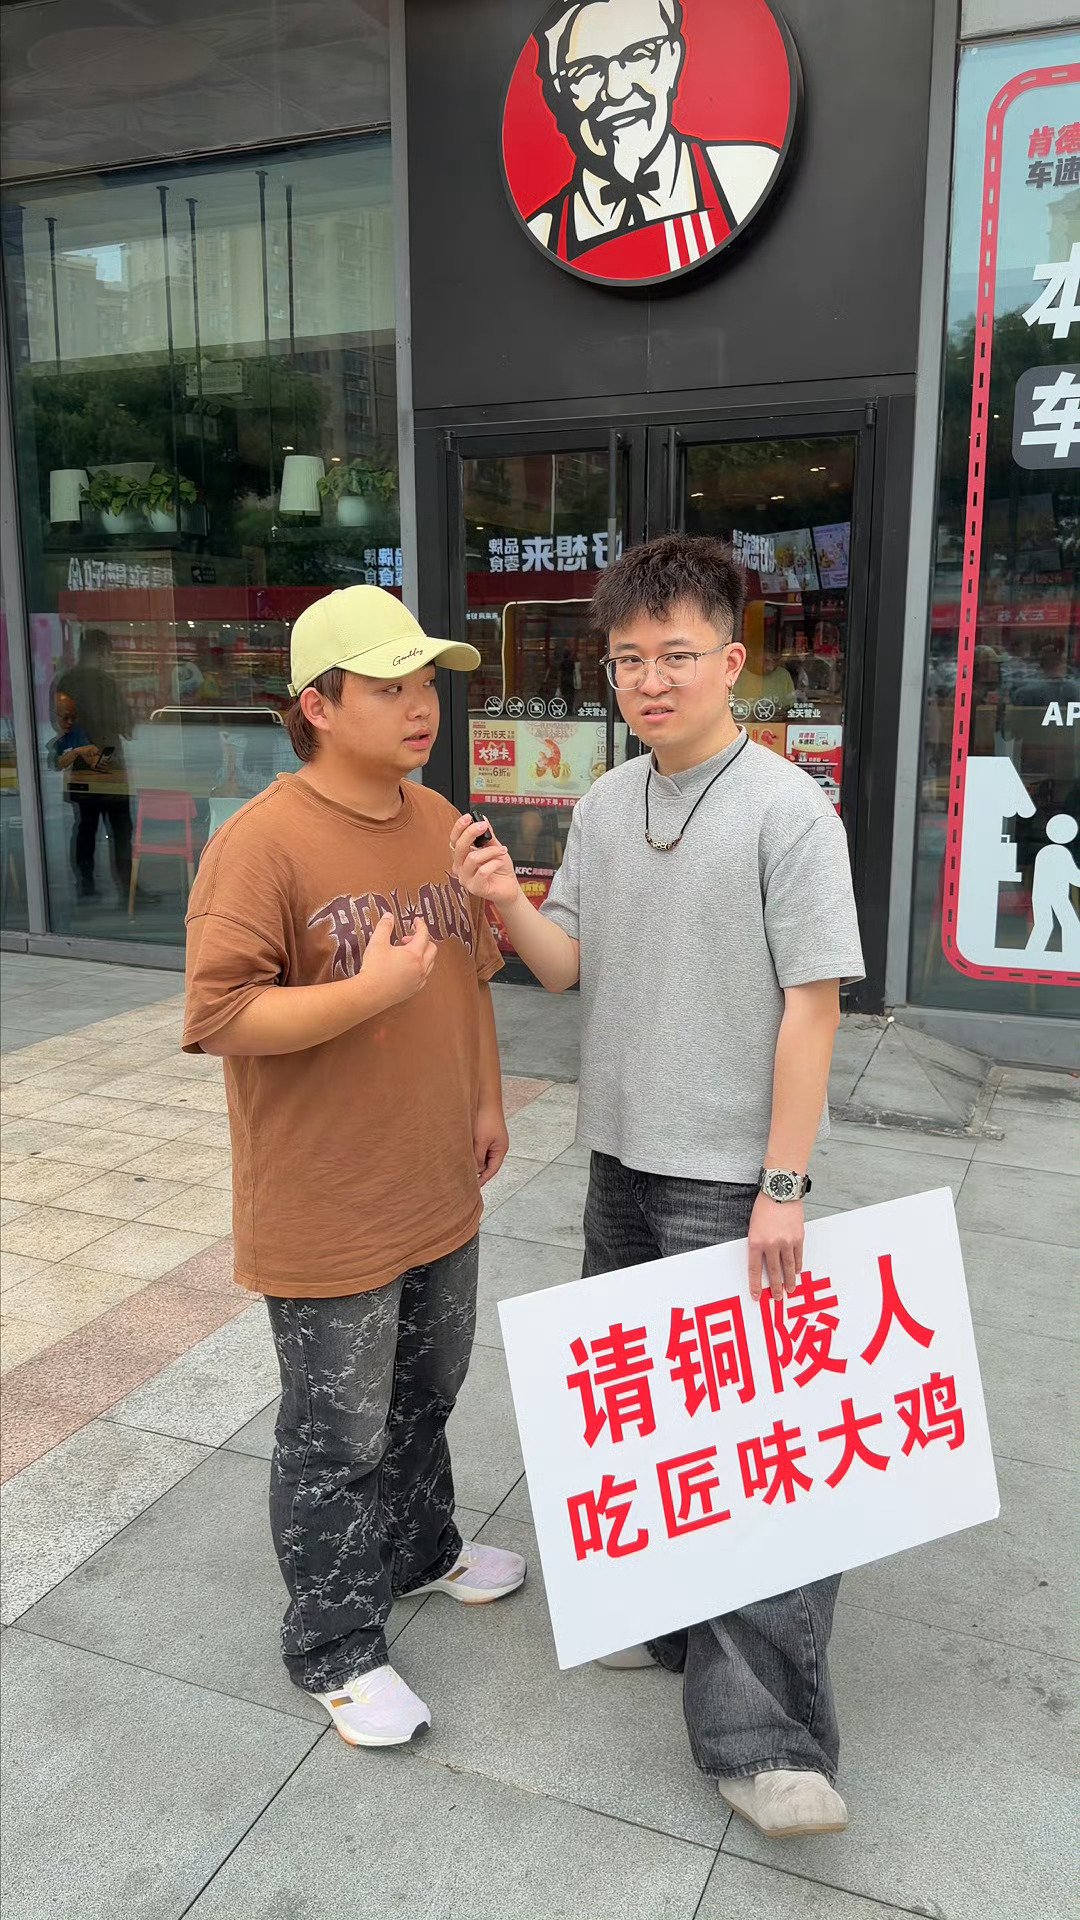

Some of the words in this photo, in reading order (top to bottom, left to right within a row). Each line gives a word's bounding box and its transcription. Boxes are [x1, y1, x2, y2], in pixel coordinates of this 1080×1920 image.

[1025, 156, 1080, 188] 车速
[577, 707, 607, 717] 全天营业
[787, 709, 821, 719] 全天营业
[515, 866, 533, 875] KFC
[566, 1254, 936, 1449] 请铜陵人
[566, 1371, 967, 1562] 吃匠味大鸡
